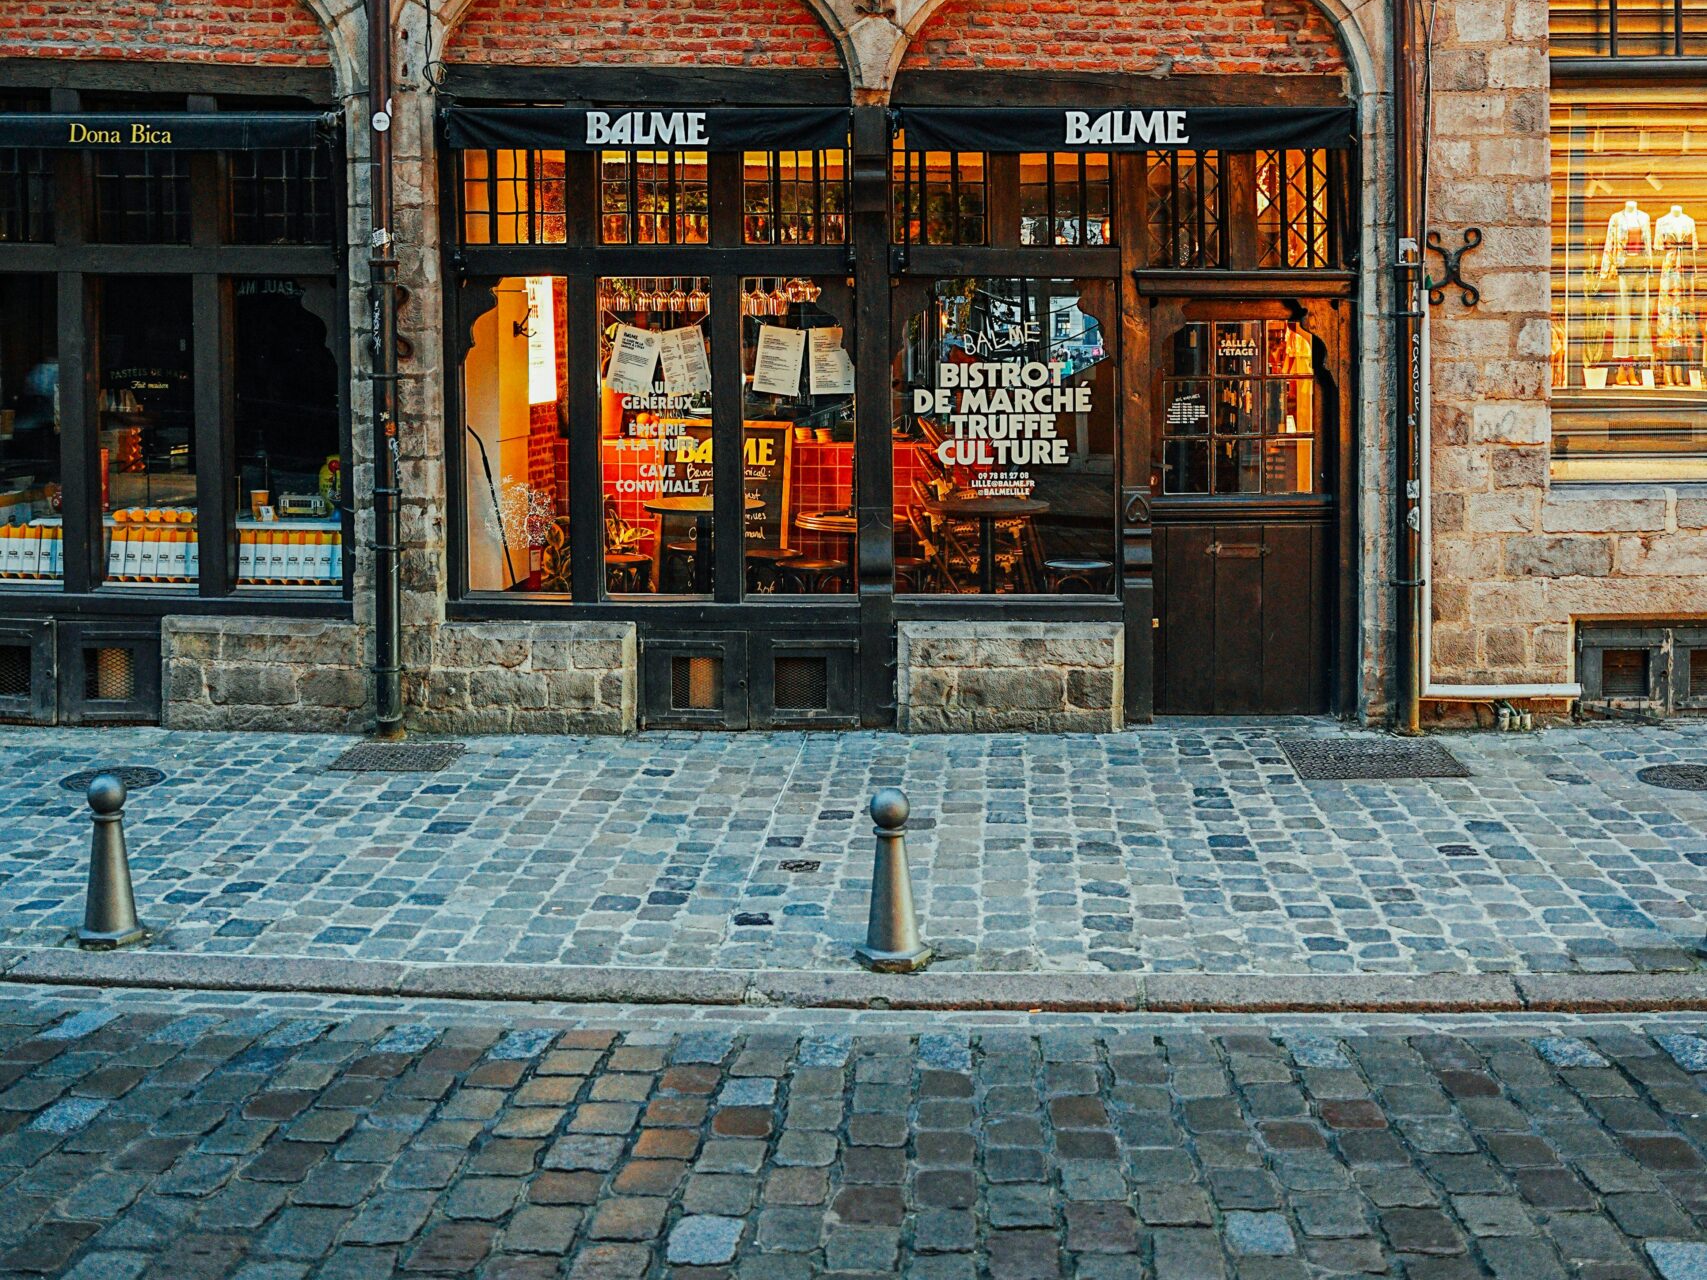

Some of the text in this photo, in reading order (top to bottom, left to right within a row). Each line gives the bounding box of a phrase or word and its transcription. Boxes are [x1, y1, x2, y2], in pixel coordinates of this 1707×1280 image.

[68, 122, 173, 144] Dona Bica
[585, 111, 710, 145] BALME
[1064, 110, 1190, 144] BALME
[963, 321, 1041, 356] BALME
[1220, 337, 1256, 348] SALLE À
[1218, 346, 1253, 356] L'ÉTAGE
[940, 361, 1066, 388] BISTROT
[913, 380, 1093, 414] DE MARCHÉ
[628, 419, 687, 436] ÉPICERIE
[950, 414, 1058, 439] TRUFFE
[615, 435, 700, 452] À LA TRUFFE
[937, 439, 1070, 465] CULTURE
[639, 464, 676, 477] CAVE
[615, 479, 700, 493] CONVIVIALE
[971, 480, 1035, 488] LILLE@BALME.FR
